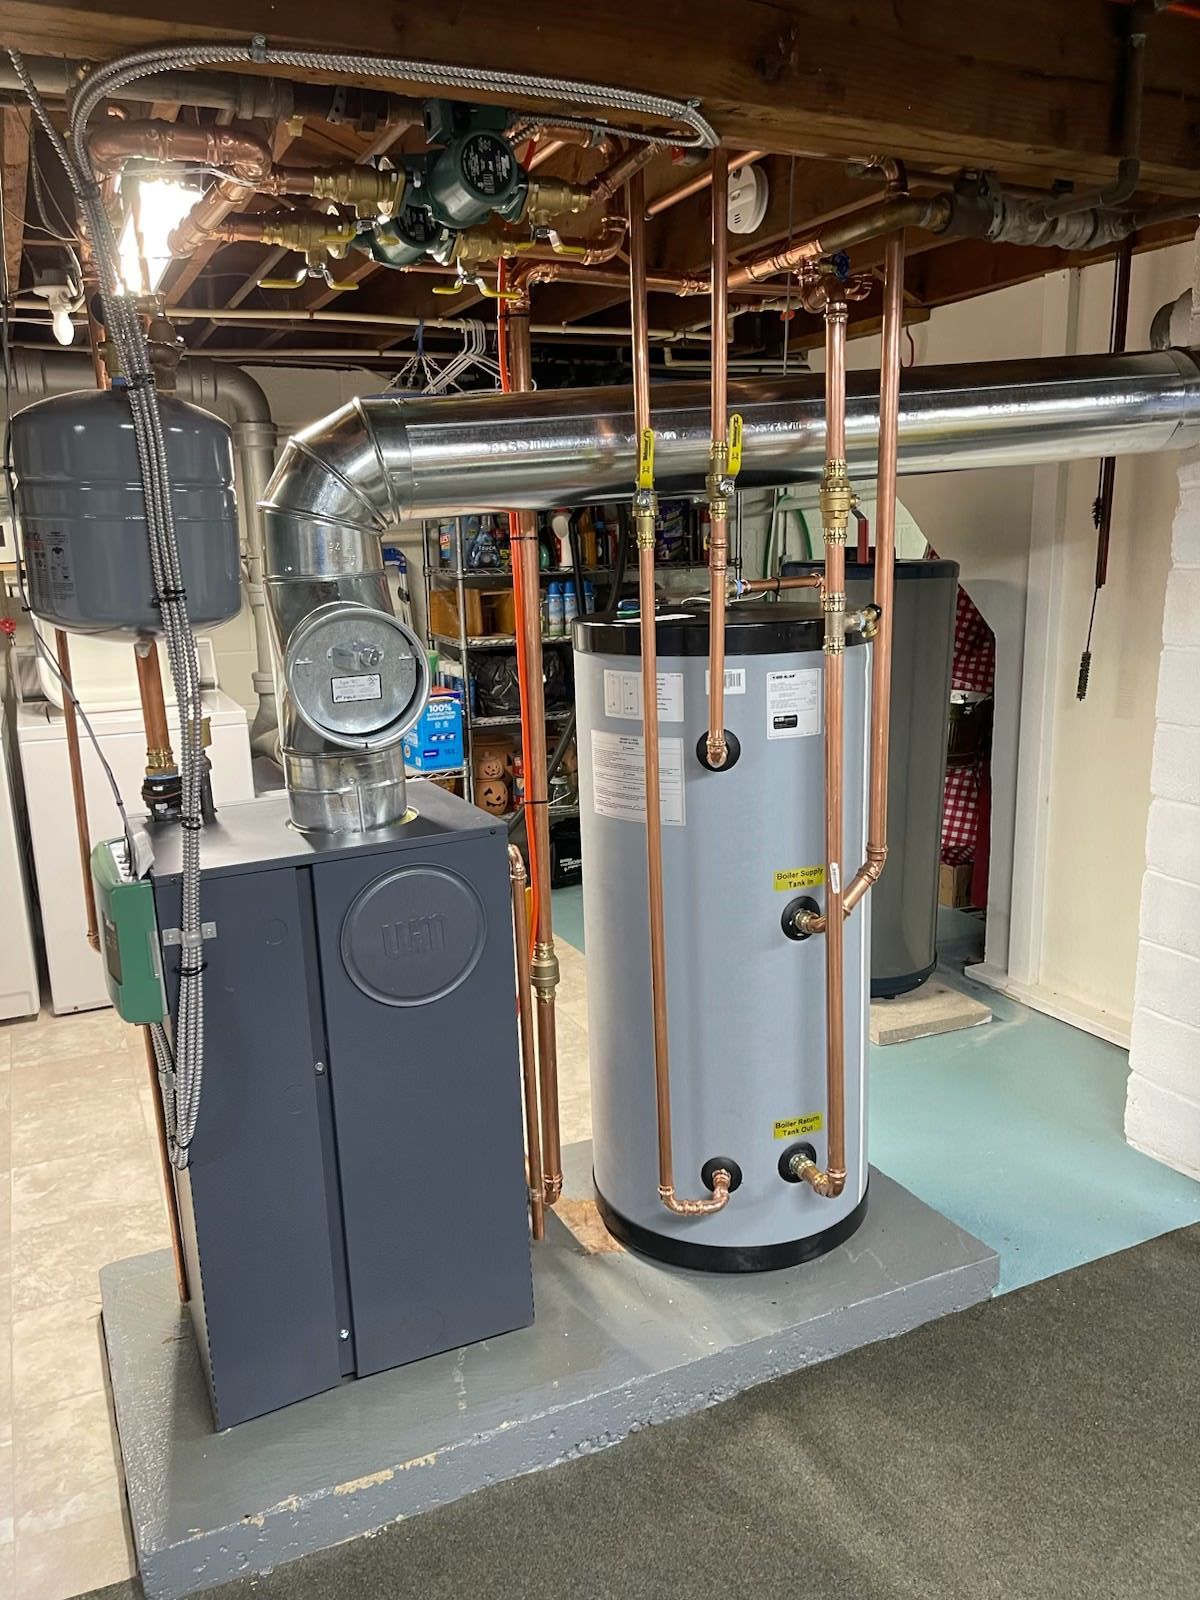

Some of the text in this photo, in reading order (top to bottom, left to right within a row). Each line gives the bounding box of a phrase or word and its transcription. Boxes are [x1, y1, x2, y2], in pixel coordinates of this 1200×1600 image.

[428, 703, 453, 713] 100%
[776, 867, 824, 881] Boiler Supply
[788, 879, 806, 888] Tank
[775, 1115, 820, 1129] Boiler Return
[783, 1125, 814, 1137] Tank Out
